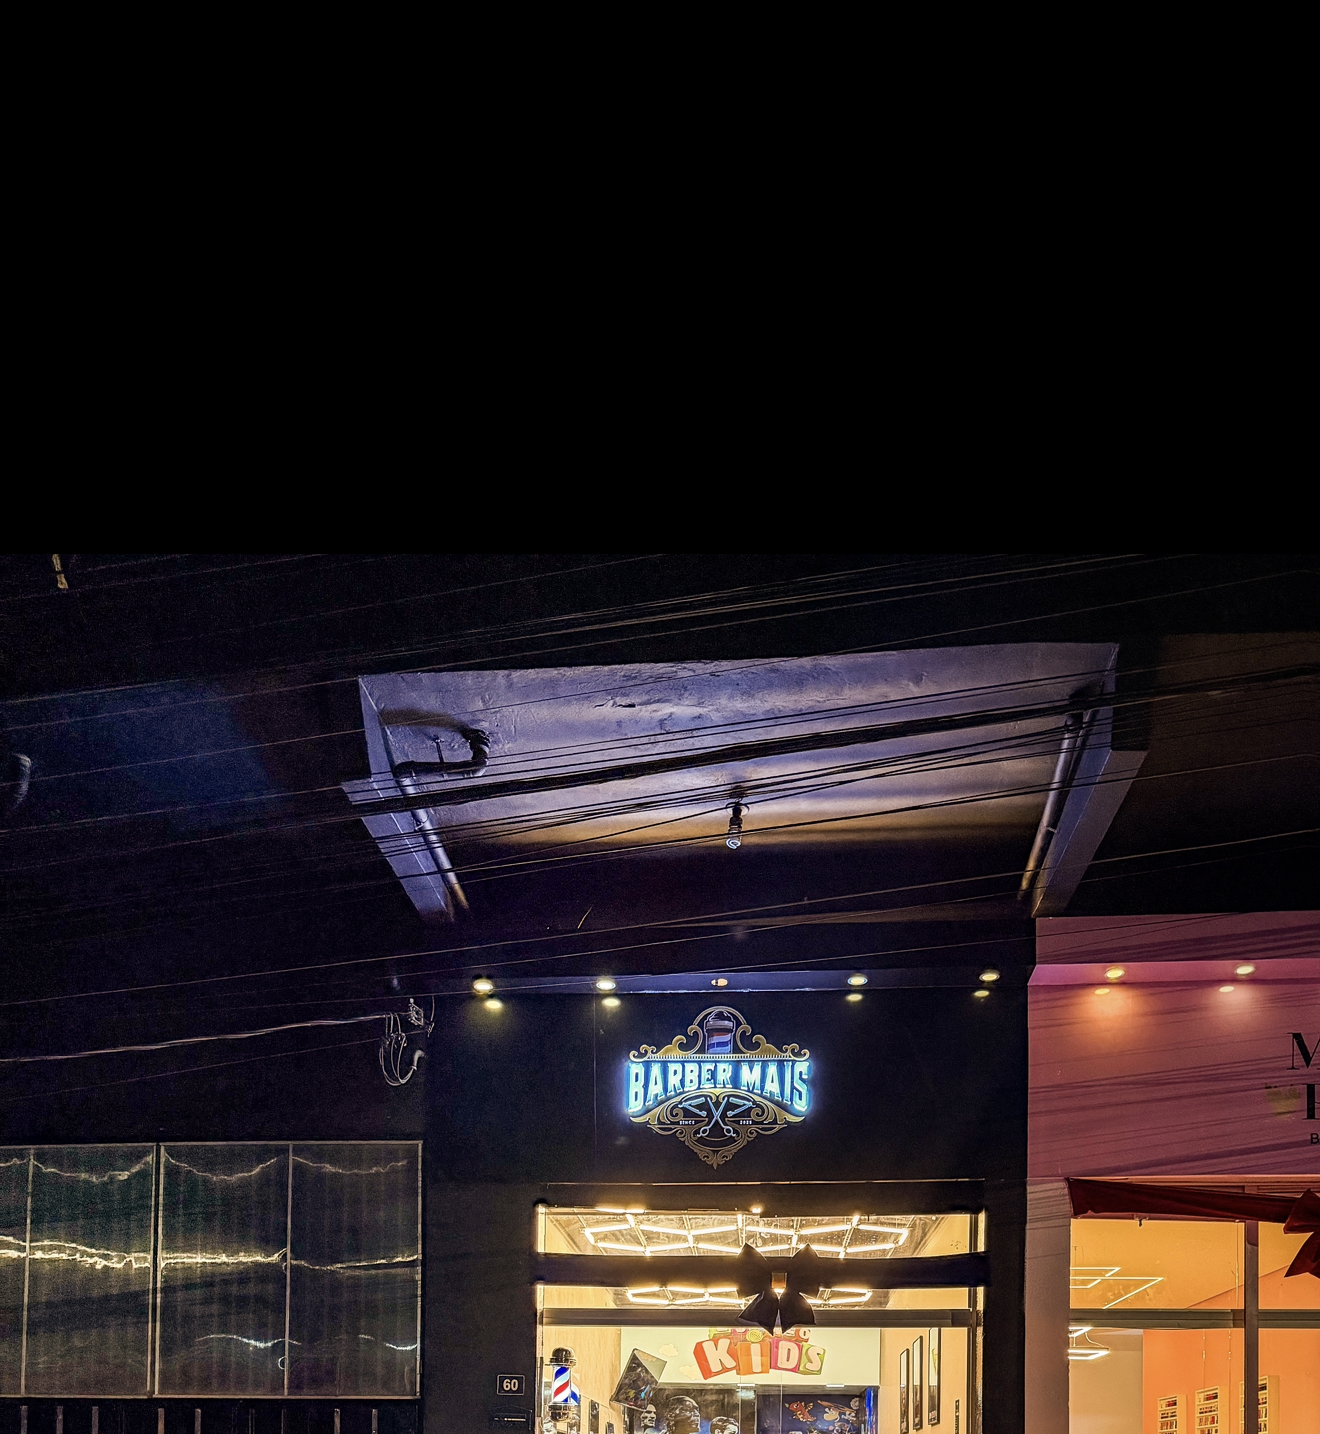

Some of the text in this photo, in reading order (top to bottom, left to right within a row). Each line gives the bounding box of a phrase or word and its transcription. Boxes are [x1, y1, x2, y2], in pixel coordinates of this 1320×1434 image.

[628, 1061, 810, 1112] BARBER MAIS
[702, 1337, 824, 1373] KIDS
[502, 1378, 519, 1391] 60
